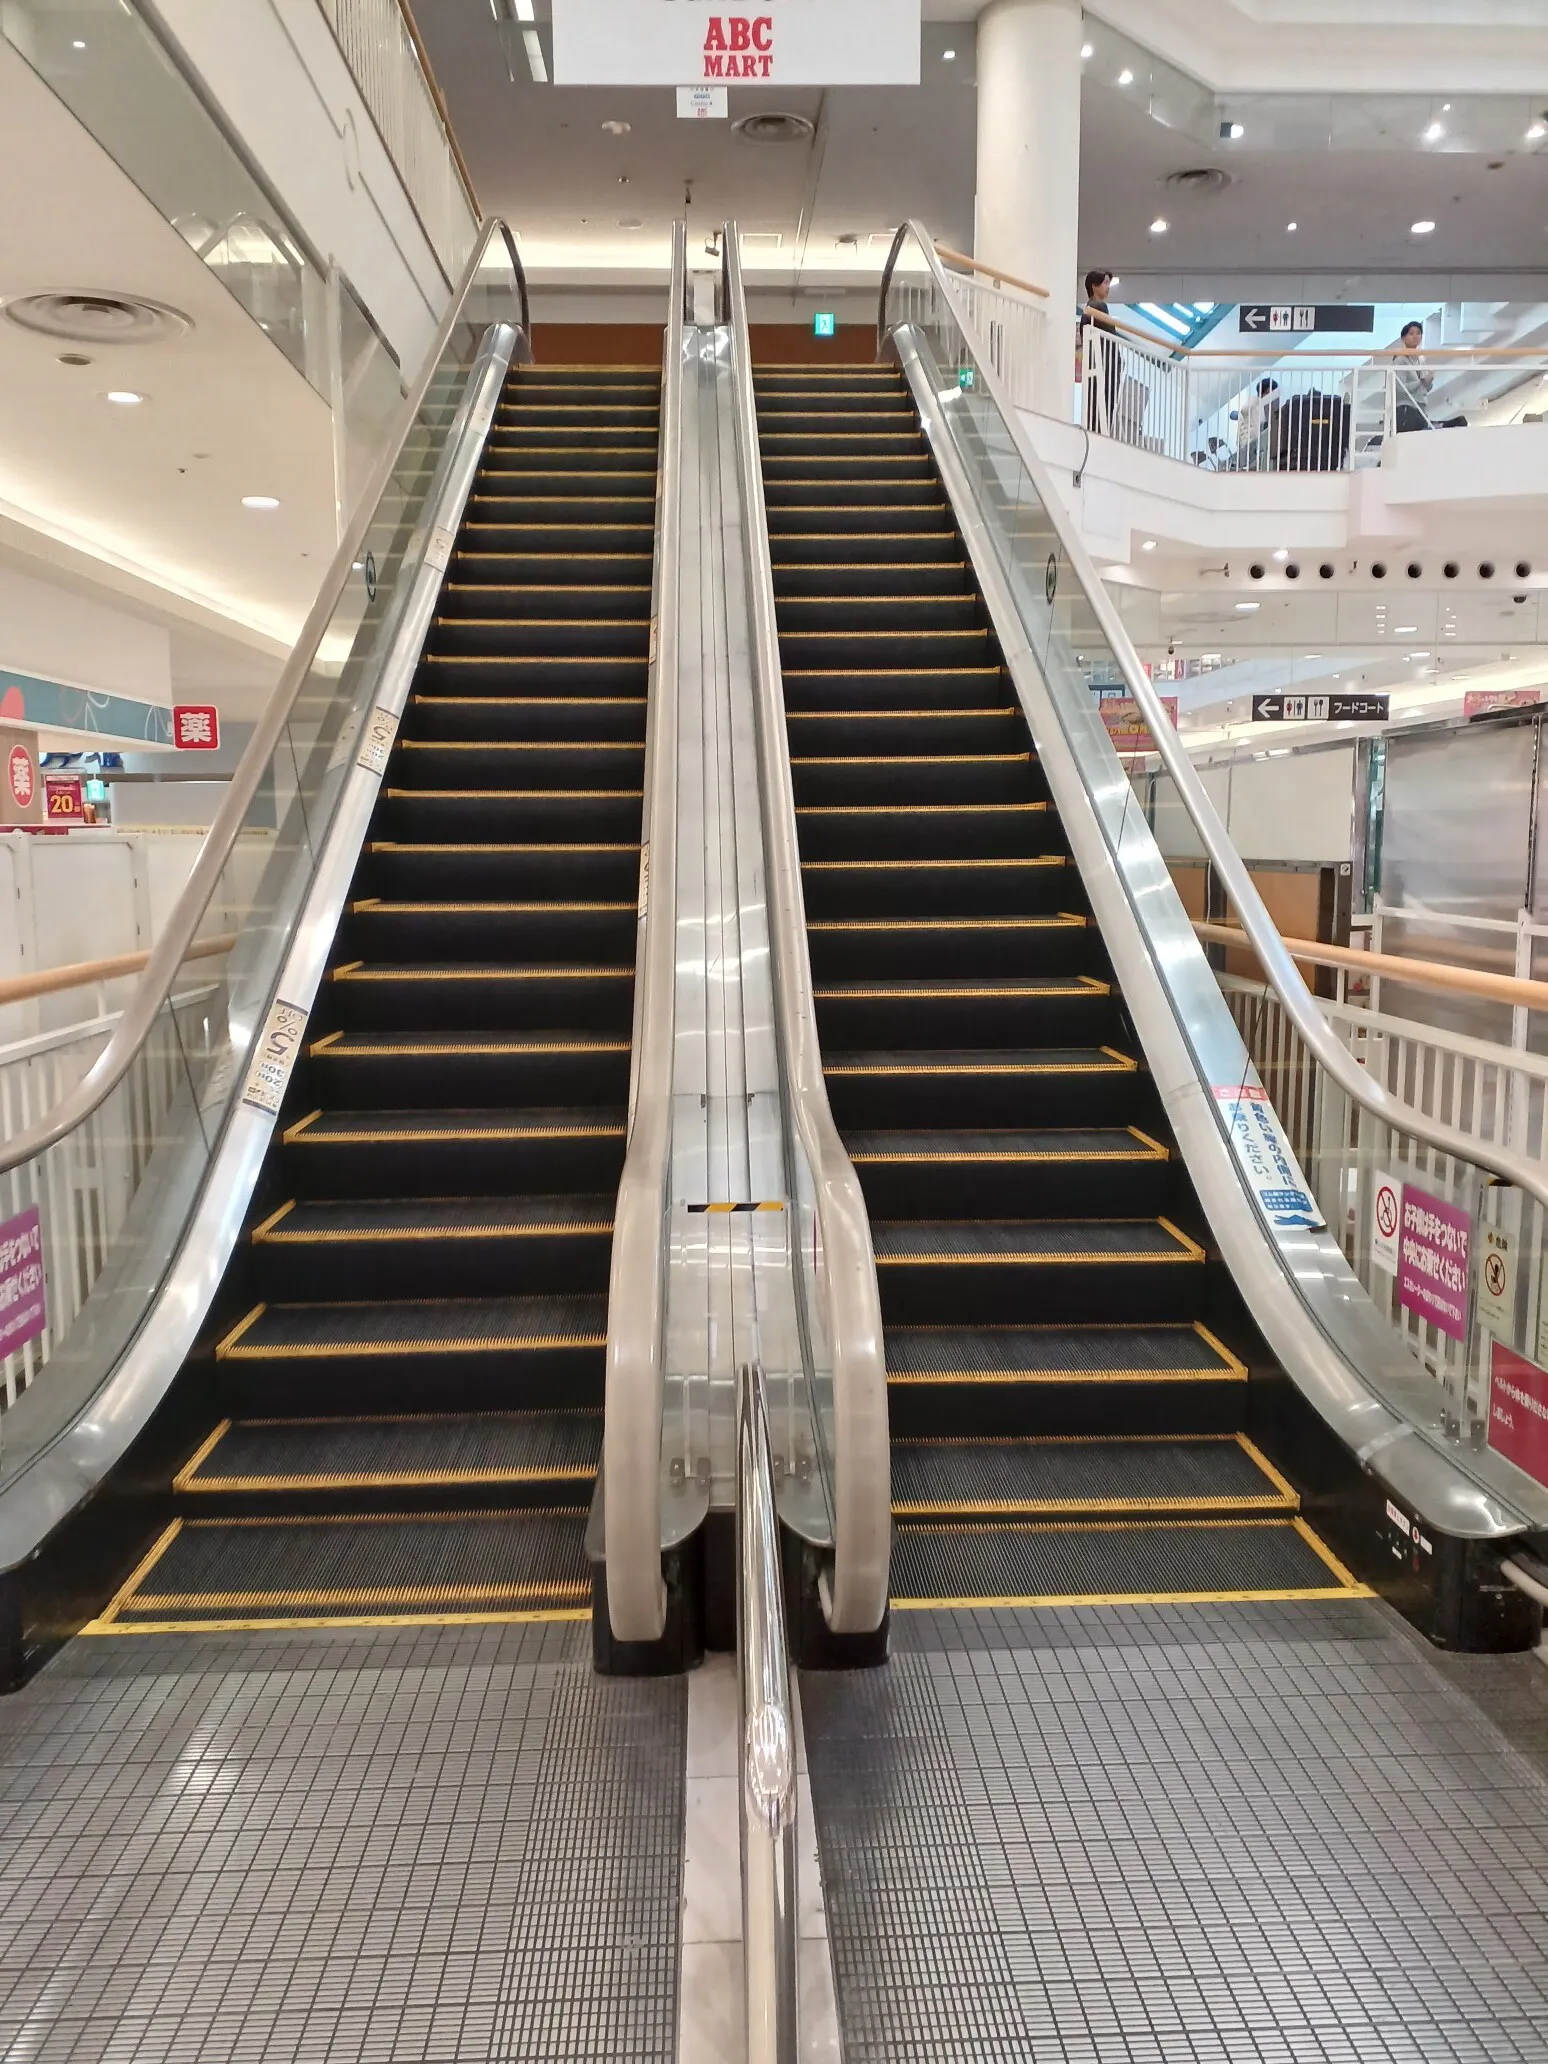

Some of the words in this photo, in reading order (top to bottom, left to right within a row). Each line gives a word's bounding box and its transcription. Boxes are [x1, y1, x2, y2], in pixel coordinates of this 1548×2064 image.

[704, 16, 773, 51] ABC
[703, 55, 774, 77] MART
[1333, 701, 1384, 715] フードコート
[179, 712, 212, 743] 薬
[12, 756, 31, 796] 薬
